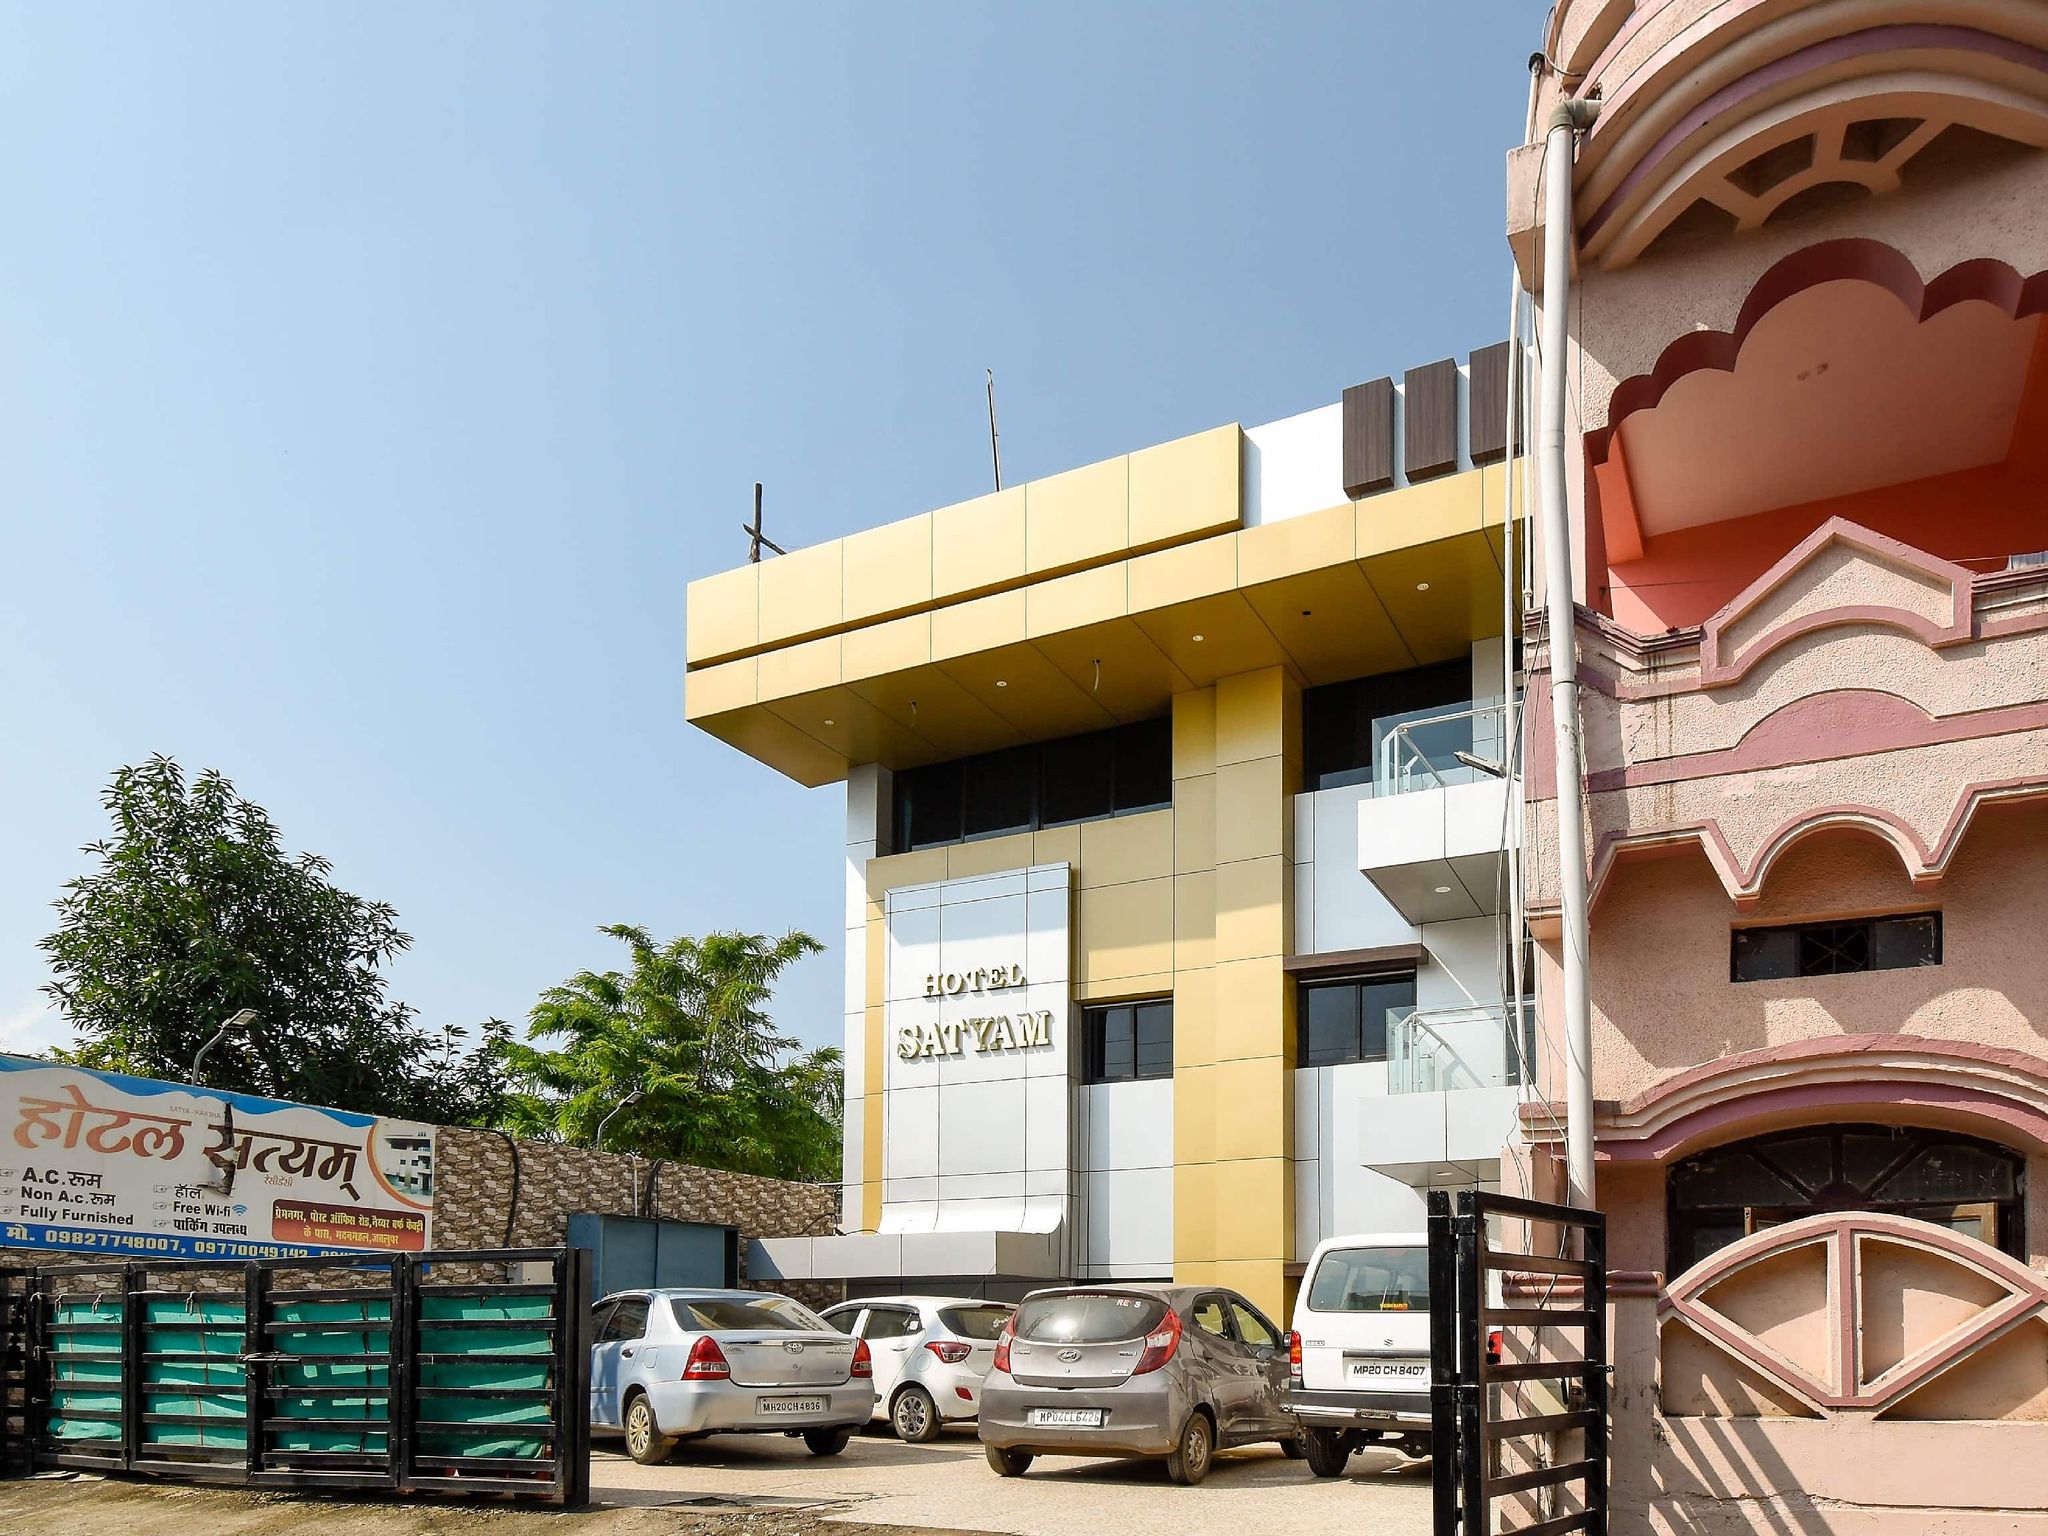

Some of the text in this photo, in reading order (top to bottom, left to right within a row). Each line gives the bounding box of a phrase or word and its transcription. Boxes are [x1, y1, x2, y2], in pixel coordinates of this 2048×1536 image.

[922, 963, 1027, 999] HOTEL
[897, 1009, 1052, 1060] SATYAM
[14, 1084, 363, 1201] होटल सत्यम्
[21, 1186, 53, 1201] Non
[20, 1204, 135, 1226] Fully Furnished
[173, 1201, 231, 1217] Free Wi-fi
[6, 1223, 36, 1242] मो.
[1353, 1365, 1425, 1376] MP20 CH 8407
